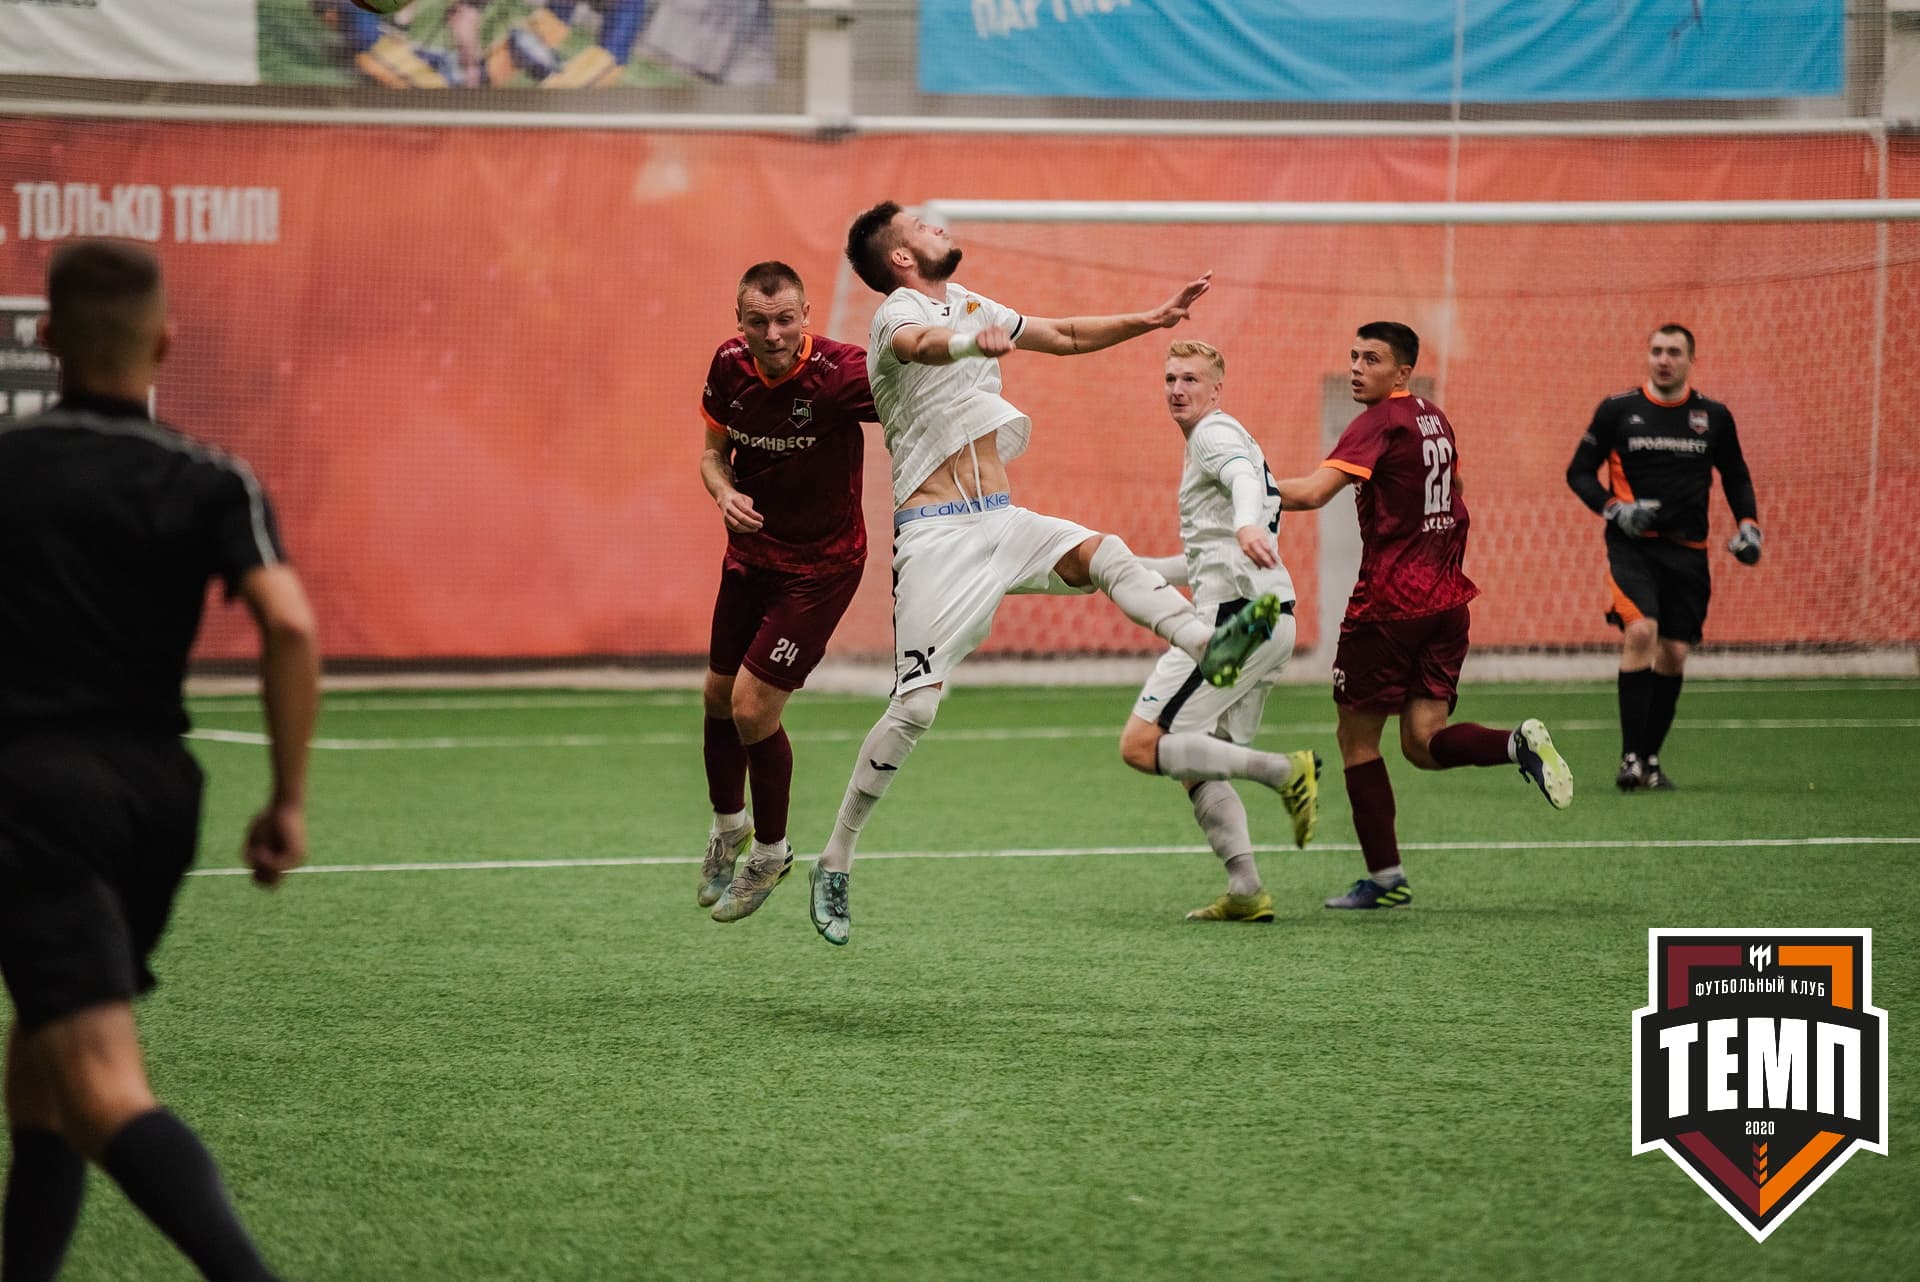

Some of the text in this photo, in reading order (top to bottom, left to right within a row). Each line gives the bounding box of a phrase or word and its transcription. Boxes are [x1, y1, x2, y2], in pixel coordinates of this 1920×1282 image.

[14, 181, 280, 243] ТОЛЬКО ТЕМП!
[1422, 437, 1453, 515] 22
[985, 494, 1010, 509] Kle
[769, 637, 799, 667] 24
